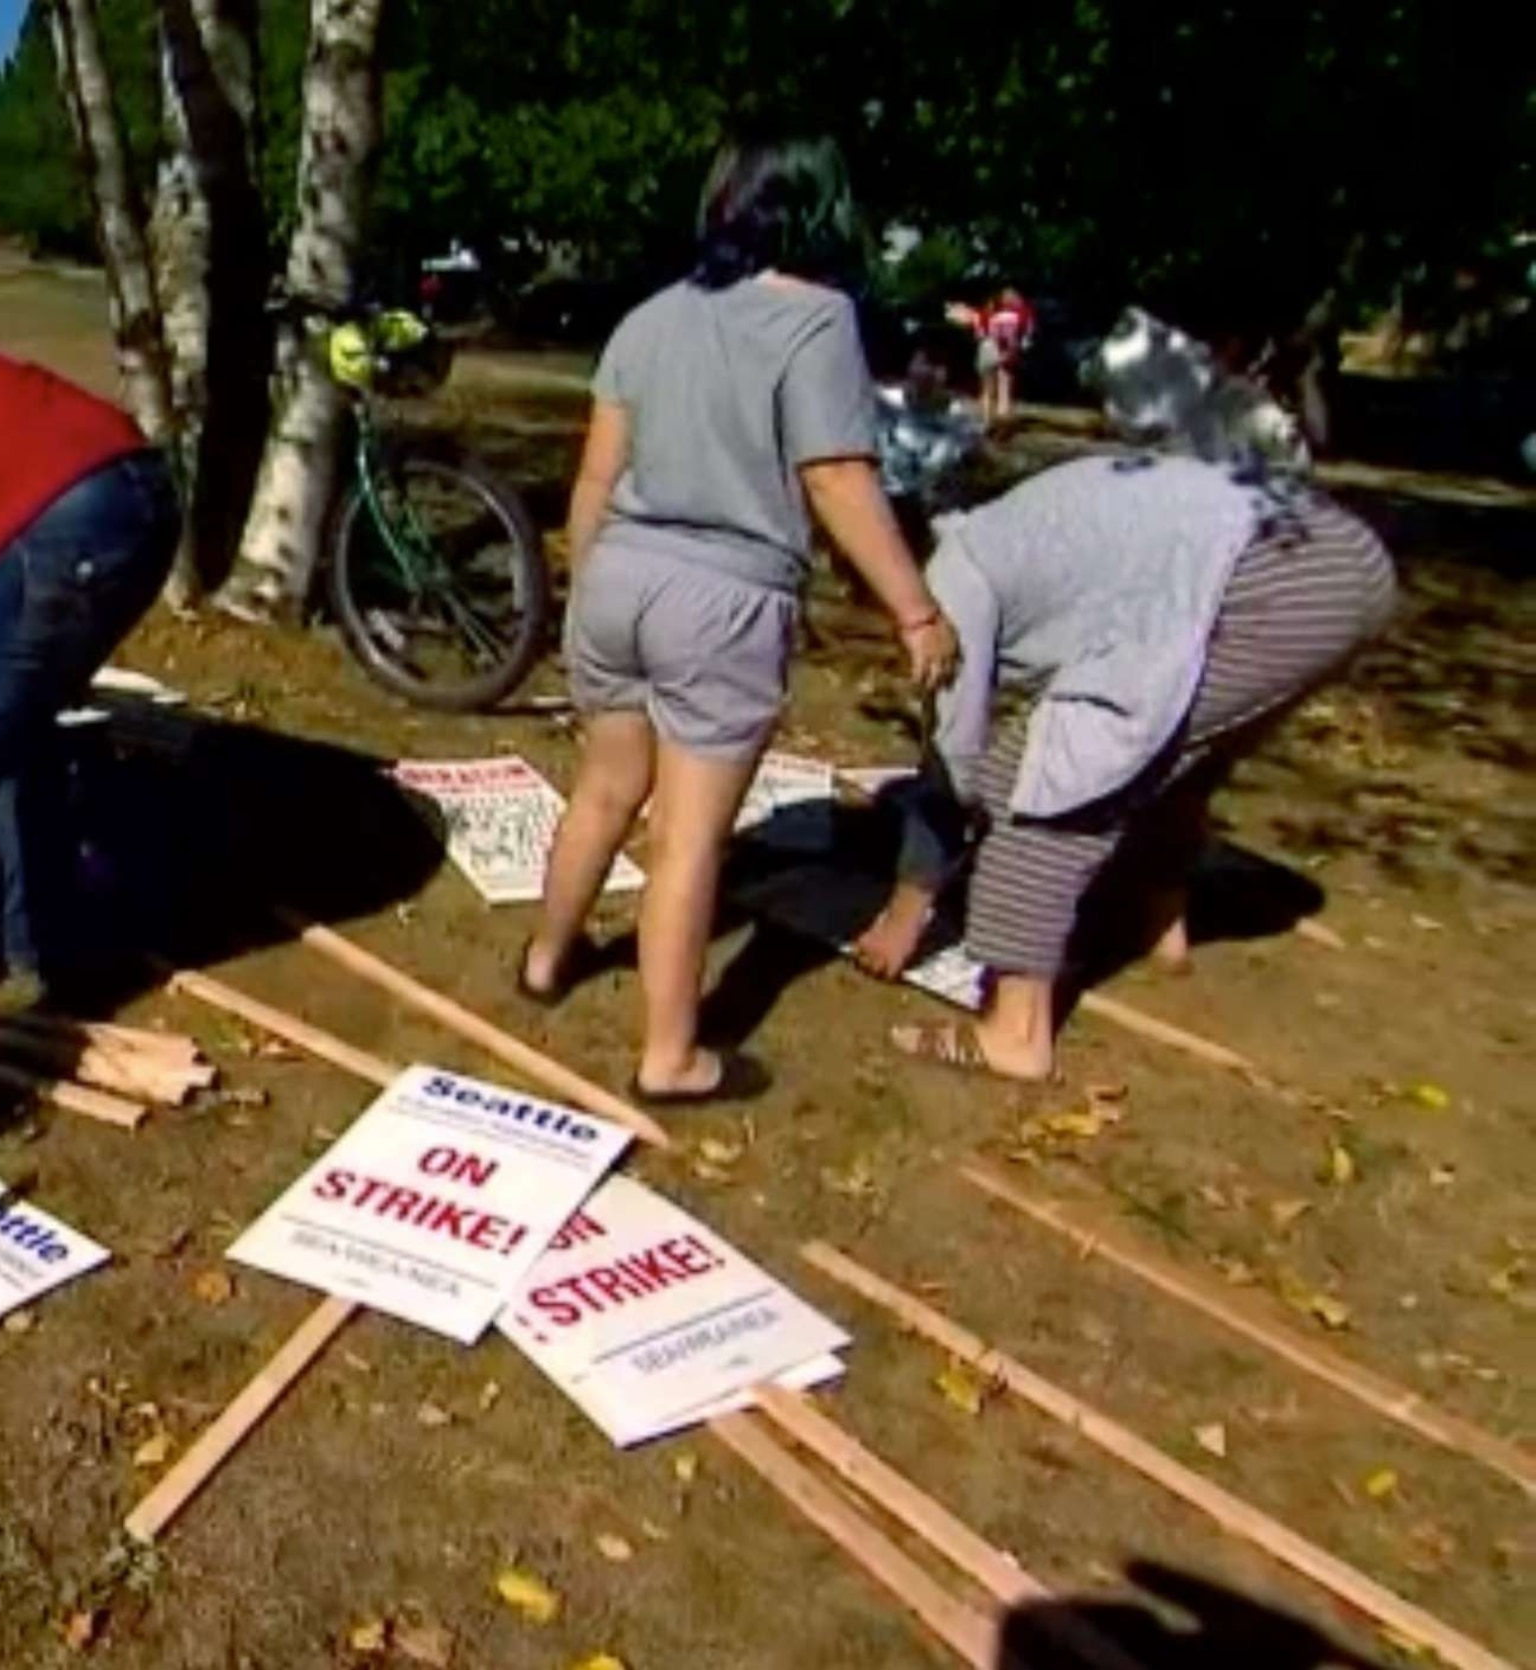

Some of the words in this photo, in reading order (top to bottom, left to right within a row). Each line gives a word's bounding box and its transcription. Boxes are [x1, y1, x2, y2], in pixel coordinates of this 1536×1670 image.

[422, 1075, 599, 1142] Seattle
[417, 1146, 500, 1188] ON
[313, 1168, 529, 1256] STRIKE!
[527, 1233, 727, 1327] STRIKE!
